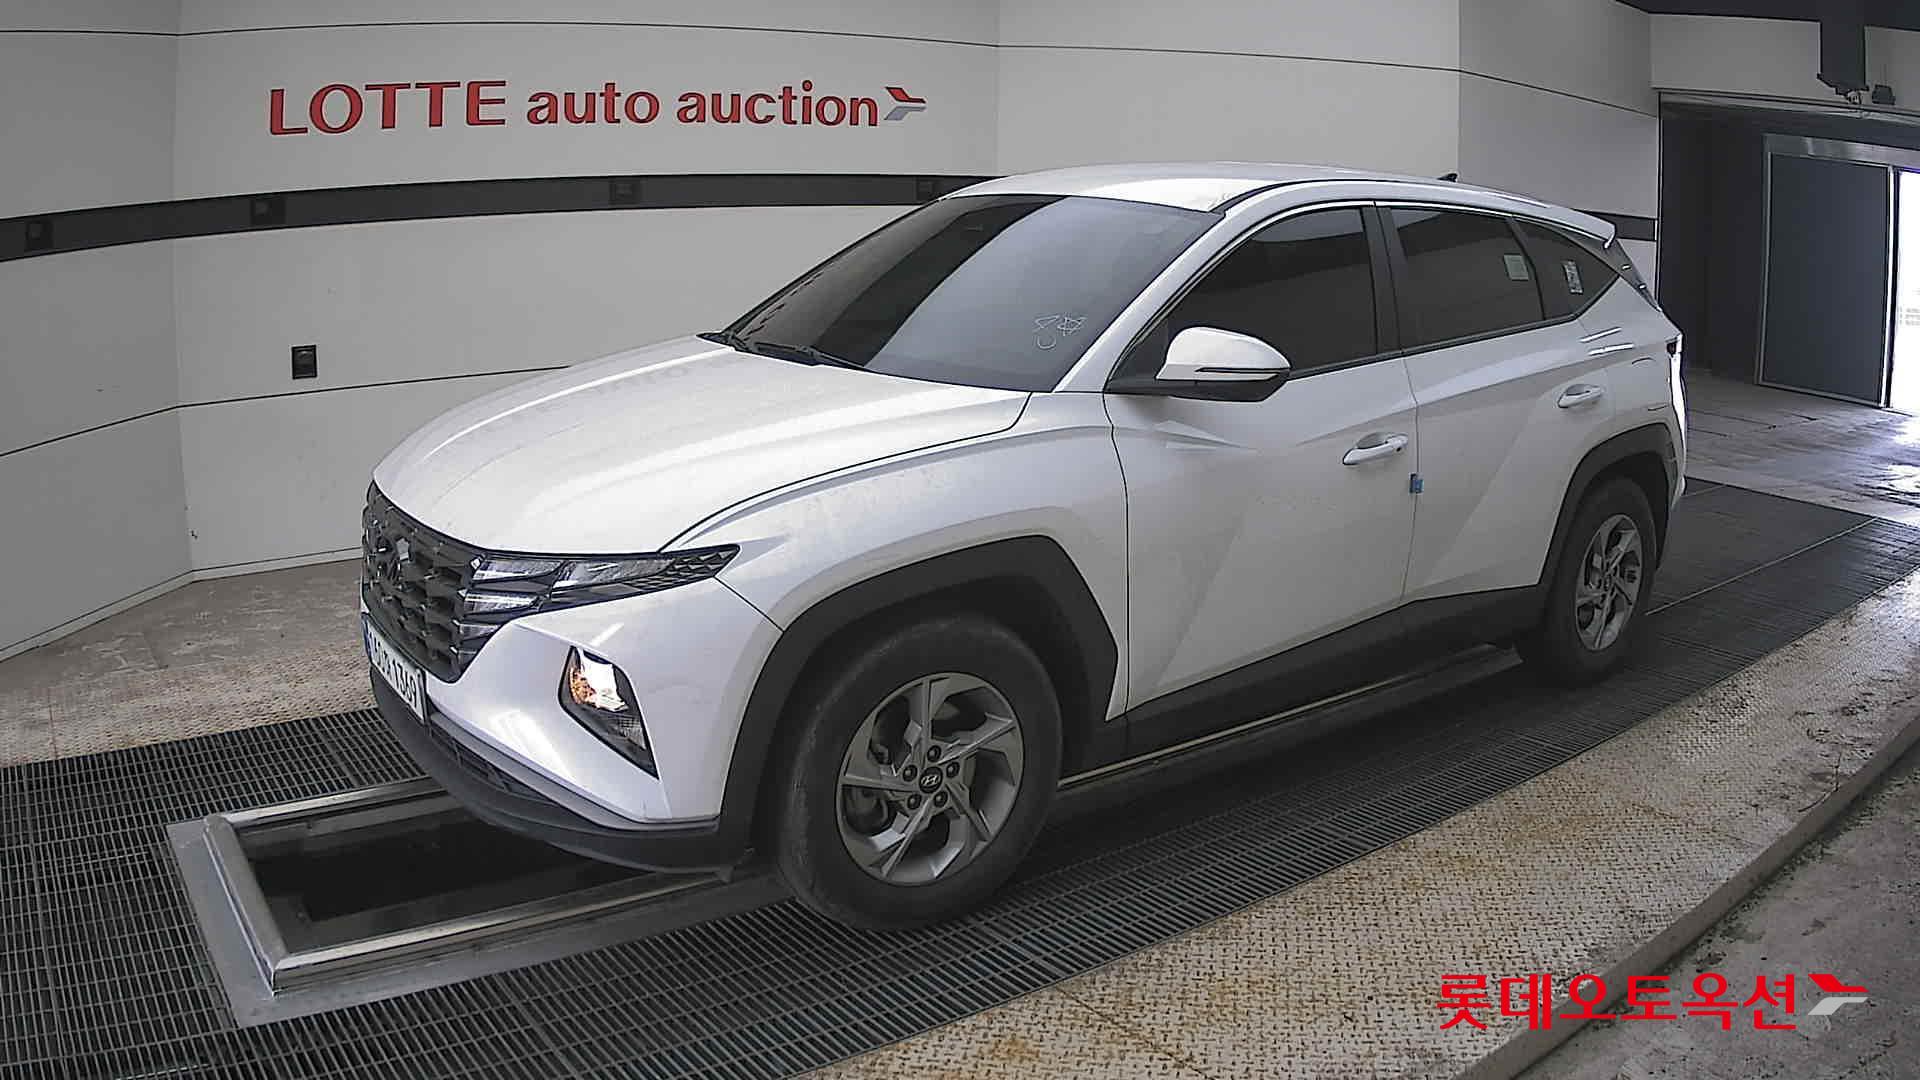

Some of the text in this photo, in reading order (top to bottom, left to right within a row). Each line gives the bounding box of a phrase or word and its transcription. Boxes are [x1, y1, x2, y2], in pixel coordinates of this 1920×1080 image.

[269, 80, 880, 135] LOTTE auto auction
